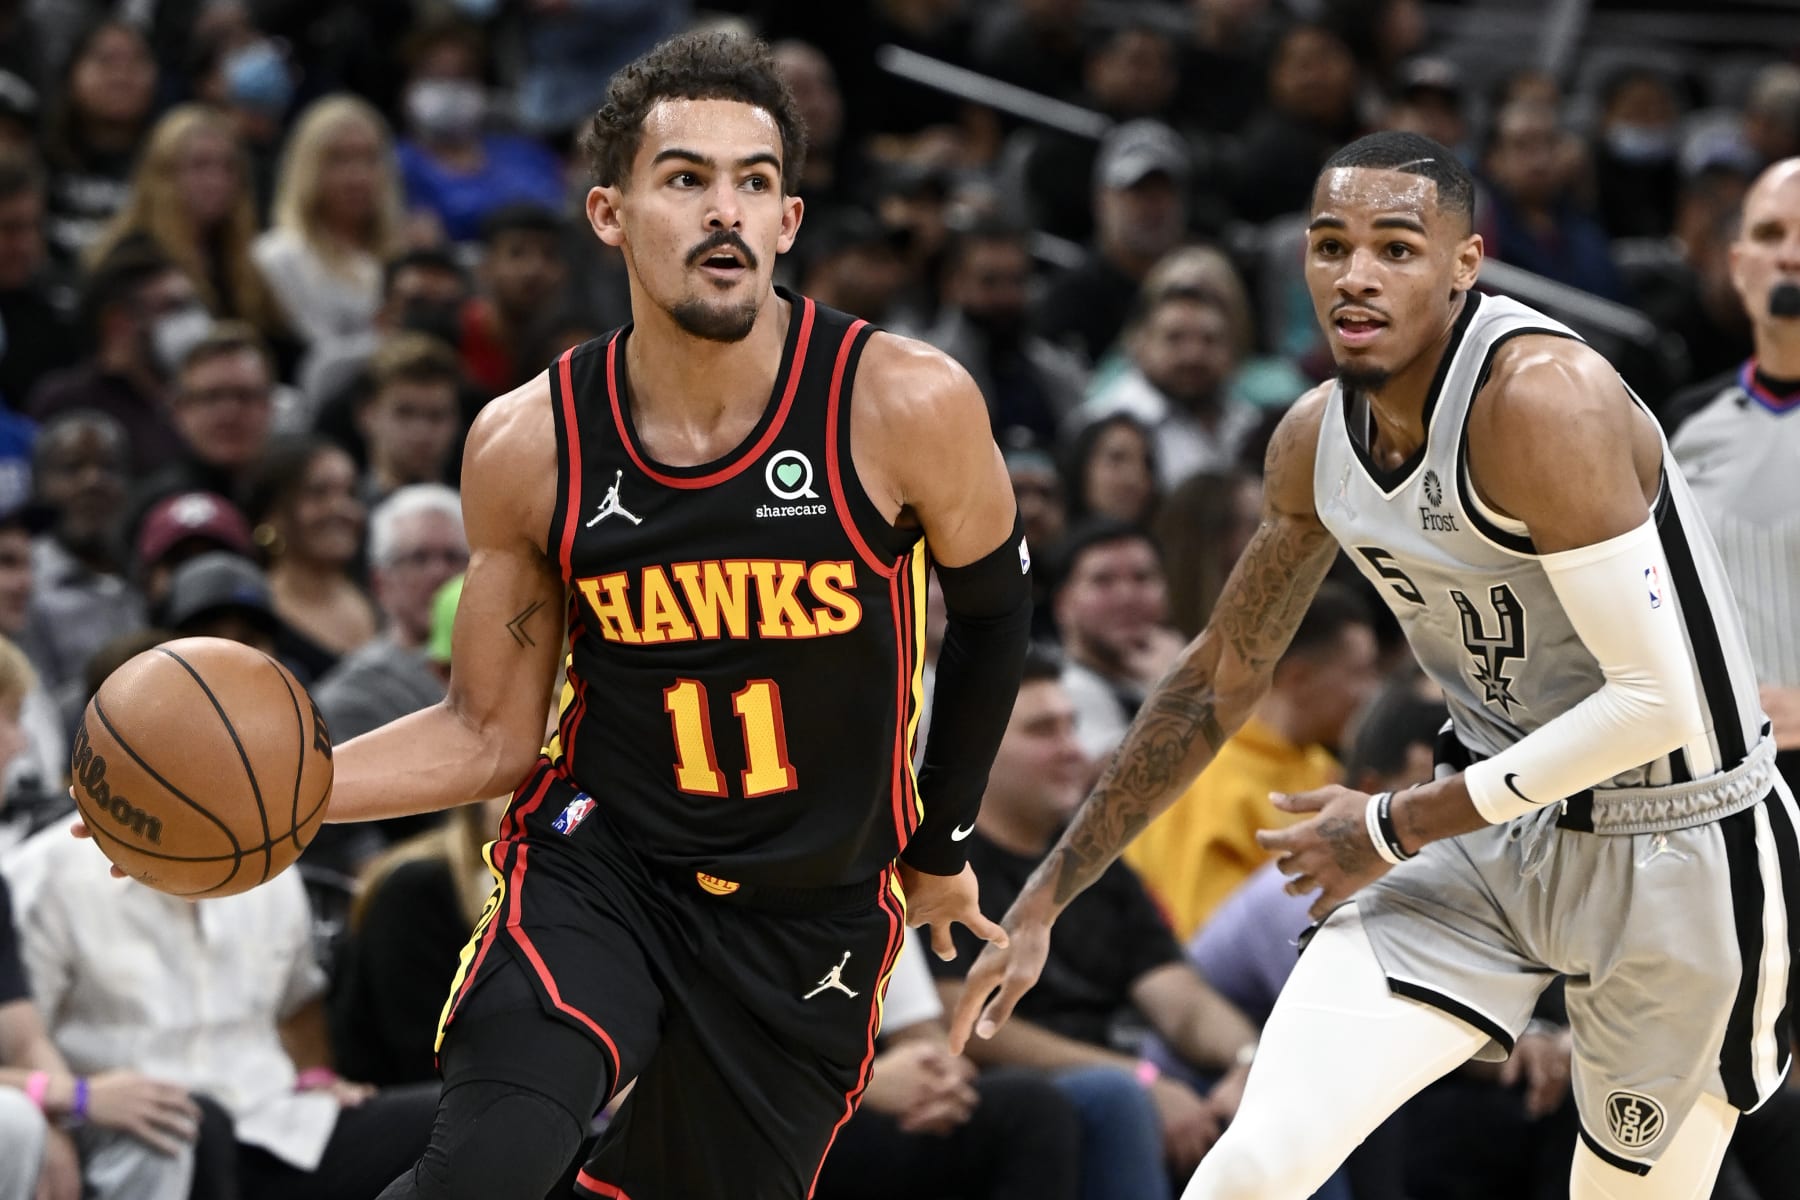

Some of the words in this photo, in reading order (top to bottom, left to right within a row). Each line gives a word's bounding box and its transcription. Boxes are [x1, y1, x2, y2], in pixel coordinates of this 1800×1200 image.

[756, 504, 827, 518] sharecare
[1420, 507, 1459, 532] Frost
[575, 558, 862, 645] HAWKS
[1354, 546, 1427, 606] 5
[663, 677, 799, 798] 11
